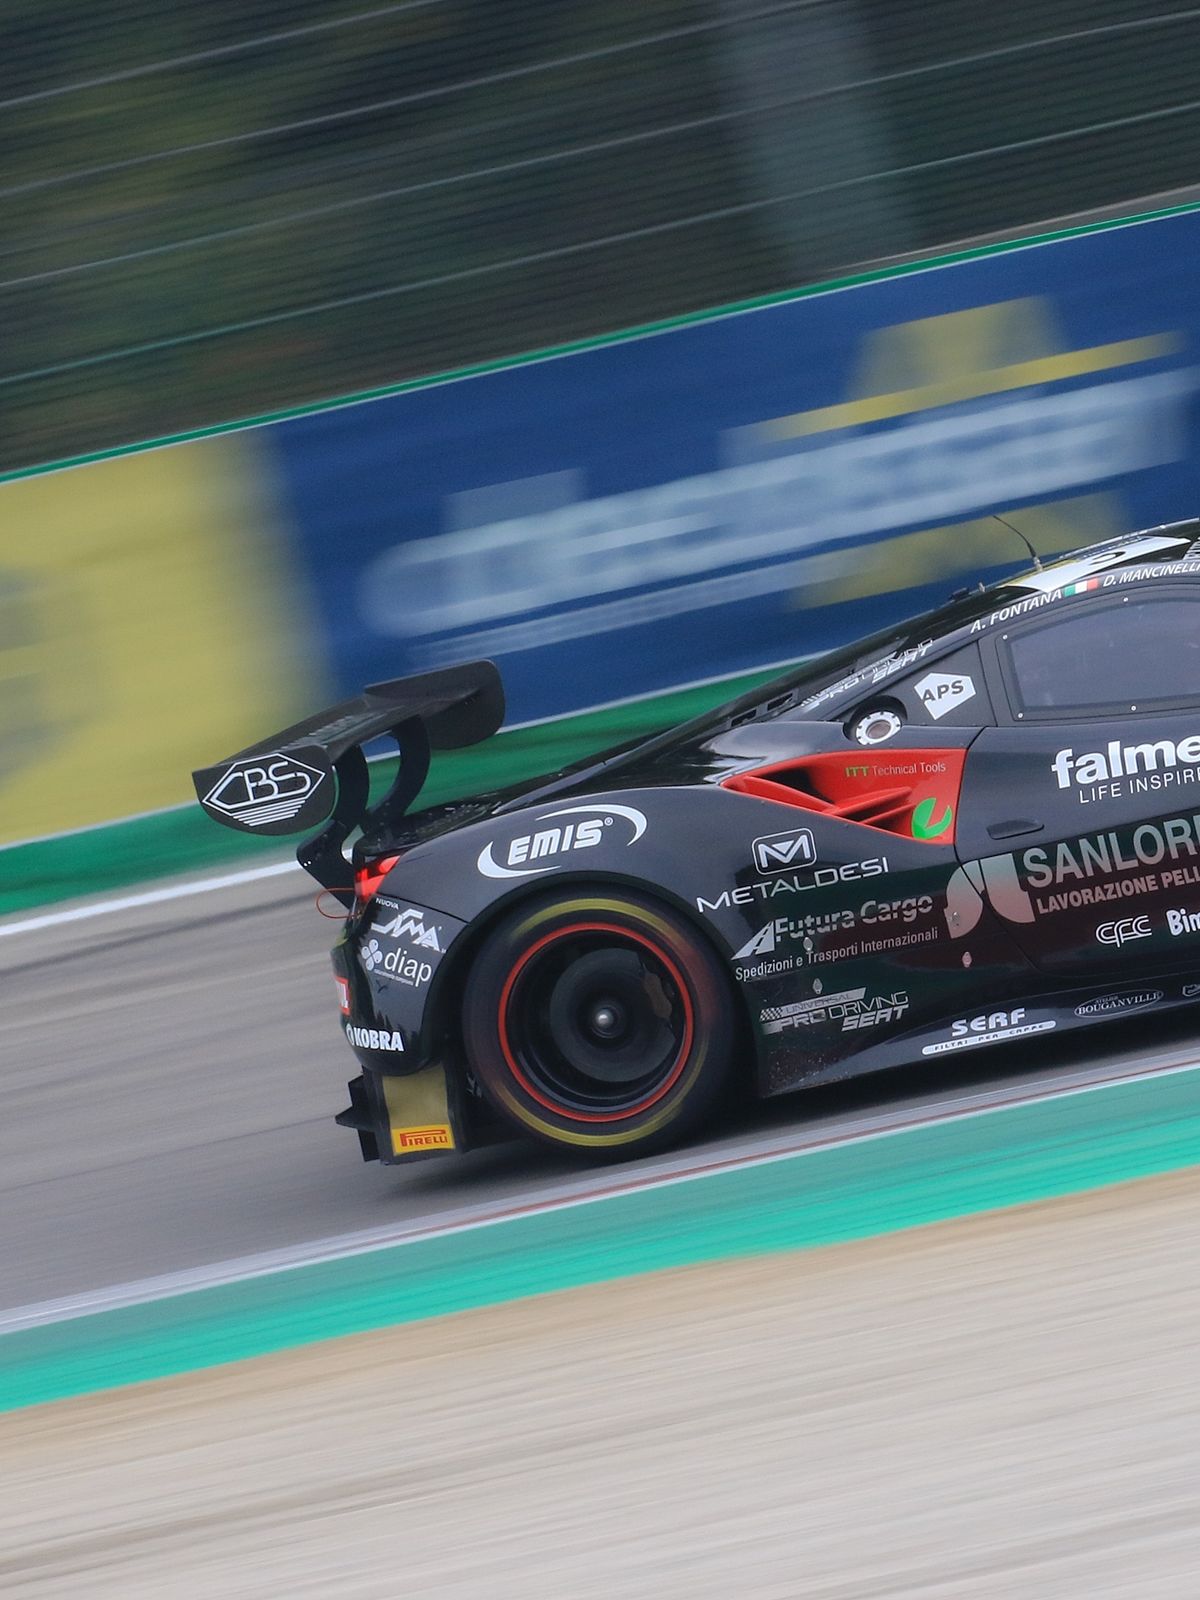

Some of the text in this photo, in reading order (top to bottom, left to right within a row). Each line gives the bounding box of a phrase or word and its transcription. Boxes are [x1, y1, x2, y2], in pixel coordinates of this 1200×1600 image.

[1102, 574, 1117, 587] D.
[970, 589, 1062, 634] A. FONTANA
[922, 680, 964, 703] APS
[845, 761, 947, 777] ITT Technical Tools
[1079, 782, 1123, 804] LIFE
[696, 856, 889, 913] METALDESI
[1036, 875, 1158, 915] LAVORAZIONE
[375, 897, 399, 910] NUOVA
[773, 895, 933, 943] Futura Cargo
[735, 927, 939, 982] Spedizioni e Trasporti Internazionali
[384, 947, 432, 988] diap
[785, 993, 853, 1014] UNIVERSAL
[828, 991, 909, 1020] DRIVING
[1078, 991, 1161, 1015] BOUGANVILLE
[841, 1004, 909, 1032] SEAT
[952, 1008, 1026, 1037] SERF
[353, 1027, 405, 1052] KOBRA
[934, 1040, 968, 1051] FILTRI
[978, 1033, 999, 1042] PER
[400, 1129, 448, 1147] PIRELLI
